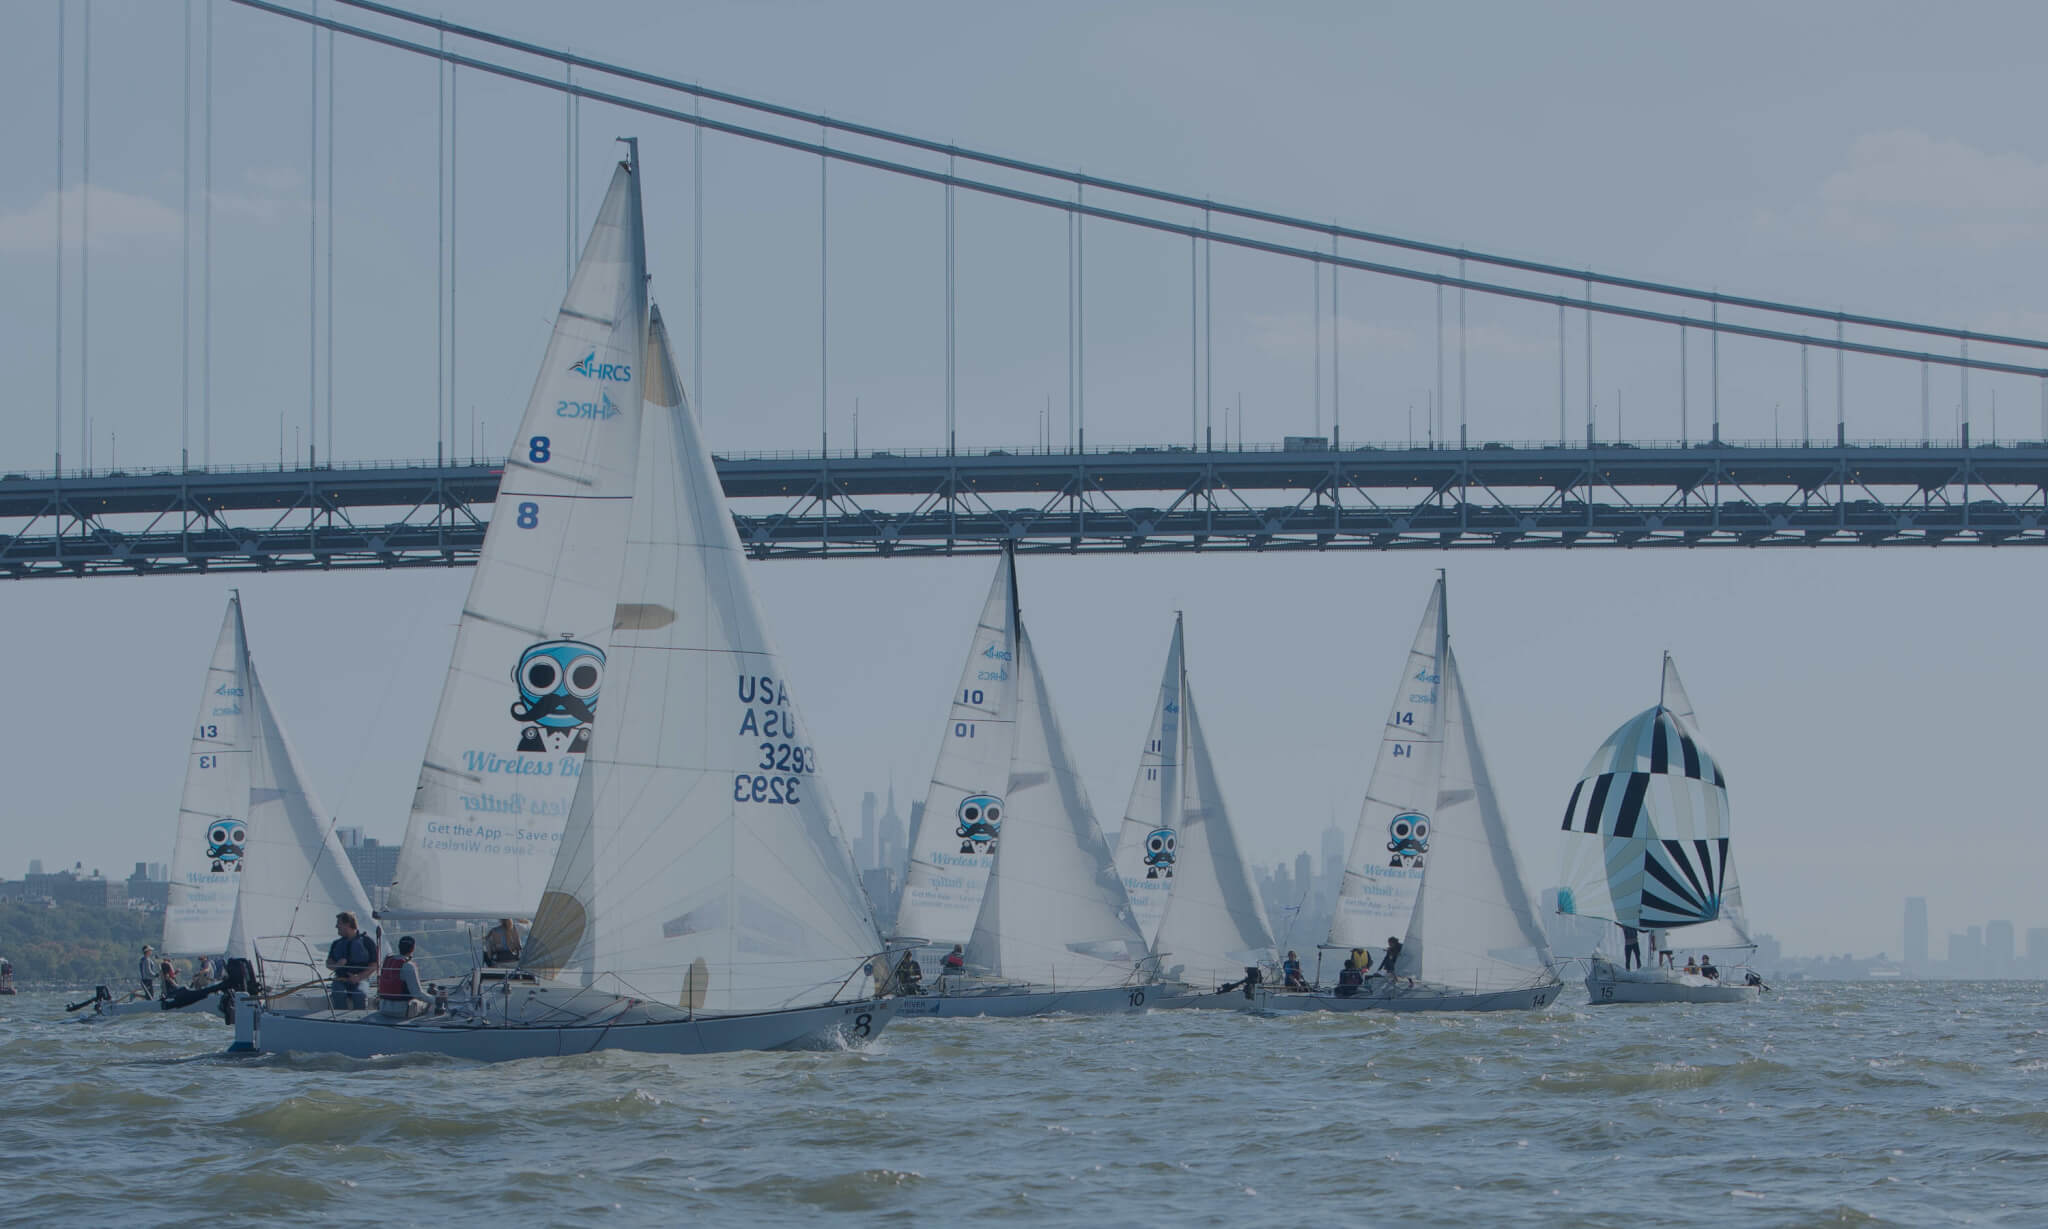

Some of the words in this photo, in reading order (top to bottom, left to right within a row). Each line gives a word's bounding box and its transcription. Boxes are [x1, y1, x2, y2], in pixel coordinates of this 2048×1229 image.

[587, 363, 632, 382] HRCS
[529, 435, 551, 464] 8
[738, 674, 792, 706] USA
[963, 688, 984, 704] 10
[1395, 711, 1414, 726] 14
[200, 724, 218, 739] 13
[1151, 739, 1162, 753] 11
[463, 750, 554, 776] Wireless
[759, 742, 817, 774] 3293
[427, 823, 450, 835] Get
[454, 824, 474, 837] the
[476, 825, 502, 842] App
[516, 828, 549, 842] Save
[1128, 991, 1145, 1007] 10
[1600, 985, 1615, 1000] 15
[853, 1013, 873, 1038] 8
